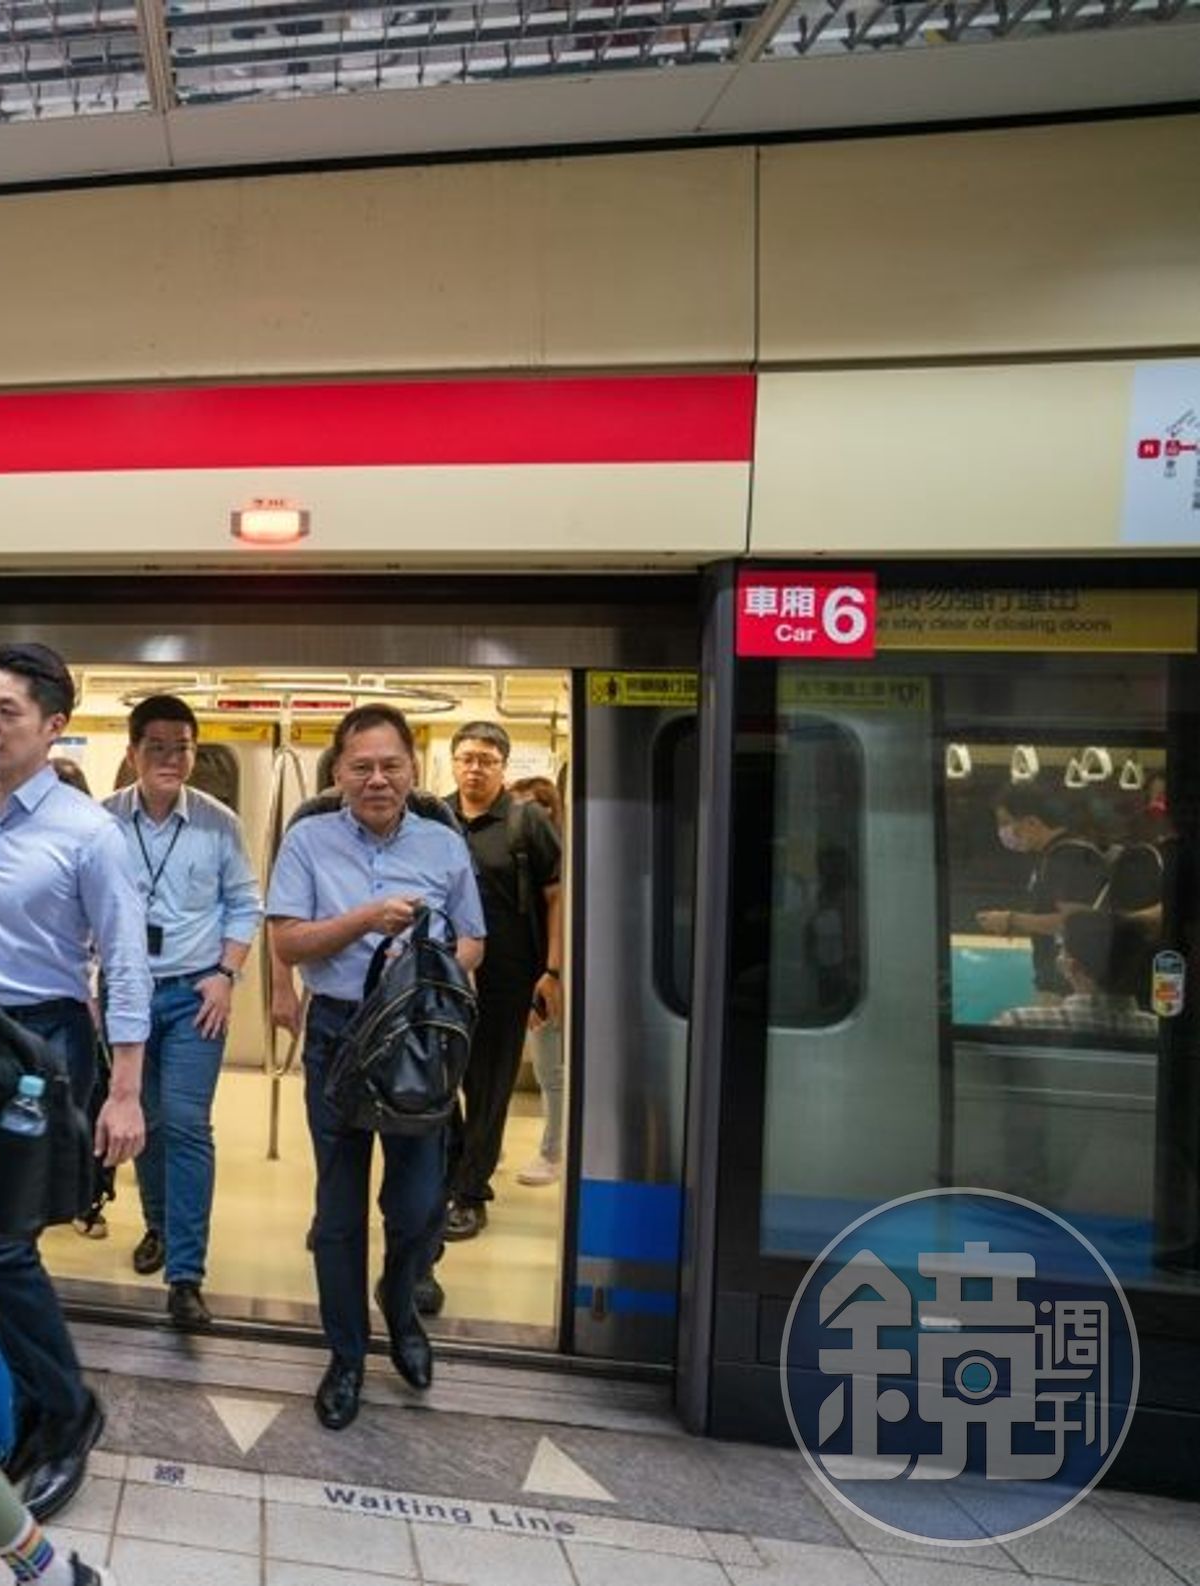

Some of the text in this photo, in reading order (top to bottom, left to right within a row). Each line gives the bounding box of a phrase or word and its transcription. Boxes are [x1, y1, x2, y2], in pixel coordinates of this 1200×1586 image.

[743, 586, 816, 618] 車廂
[822, 586, 867, 644] 6
[774, 624, 817, 642] Car
[324, 1487, 576, 1535] Waiting Line
